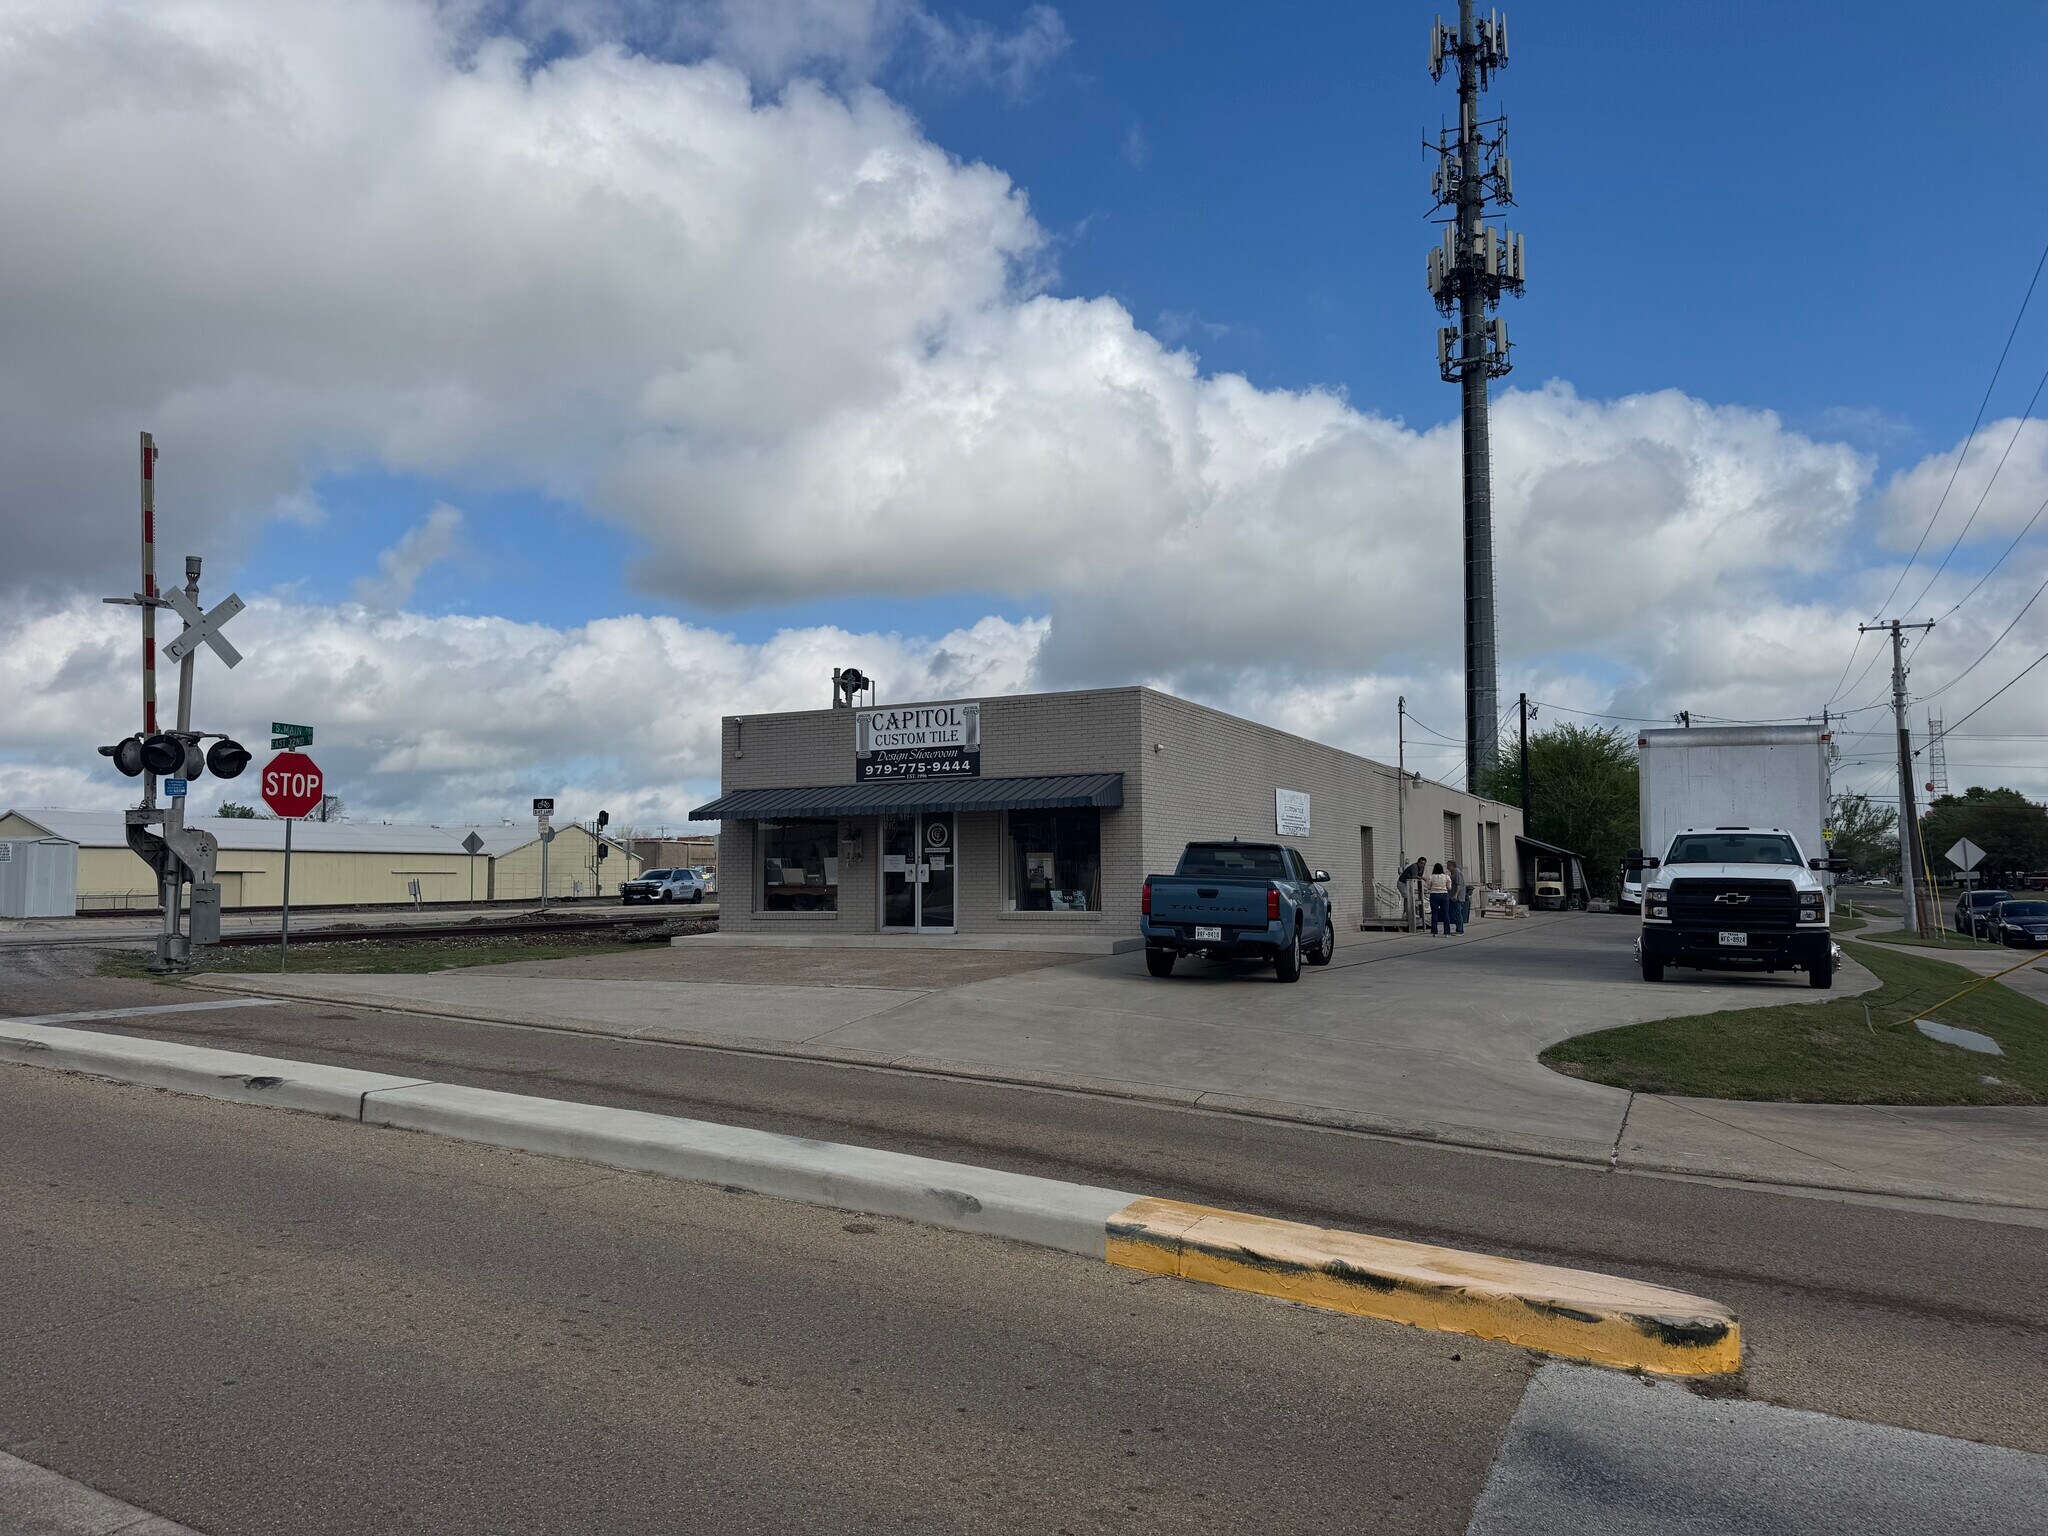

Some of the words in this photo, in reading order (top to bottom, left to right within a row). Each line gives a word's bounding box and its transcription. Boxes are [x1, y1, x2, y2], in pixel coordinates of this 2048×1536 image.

[871, 707, 961, 732] CAPITOL
[875, 732, 926, 746] CUSTOM
[929, 730, 959, 743] TILE
[877, 750, 908, 763] Design
[909, 748, 958, 760] Showroom
[865, 760, 971, 775] 979-775-9444
[265, 771, 320, 797] STOP
[1169, 904, 1248, 912] TACOMA
